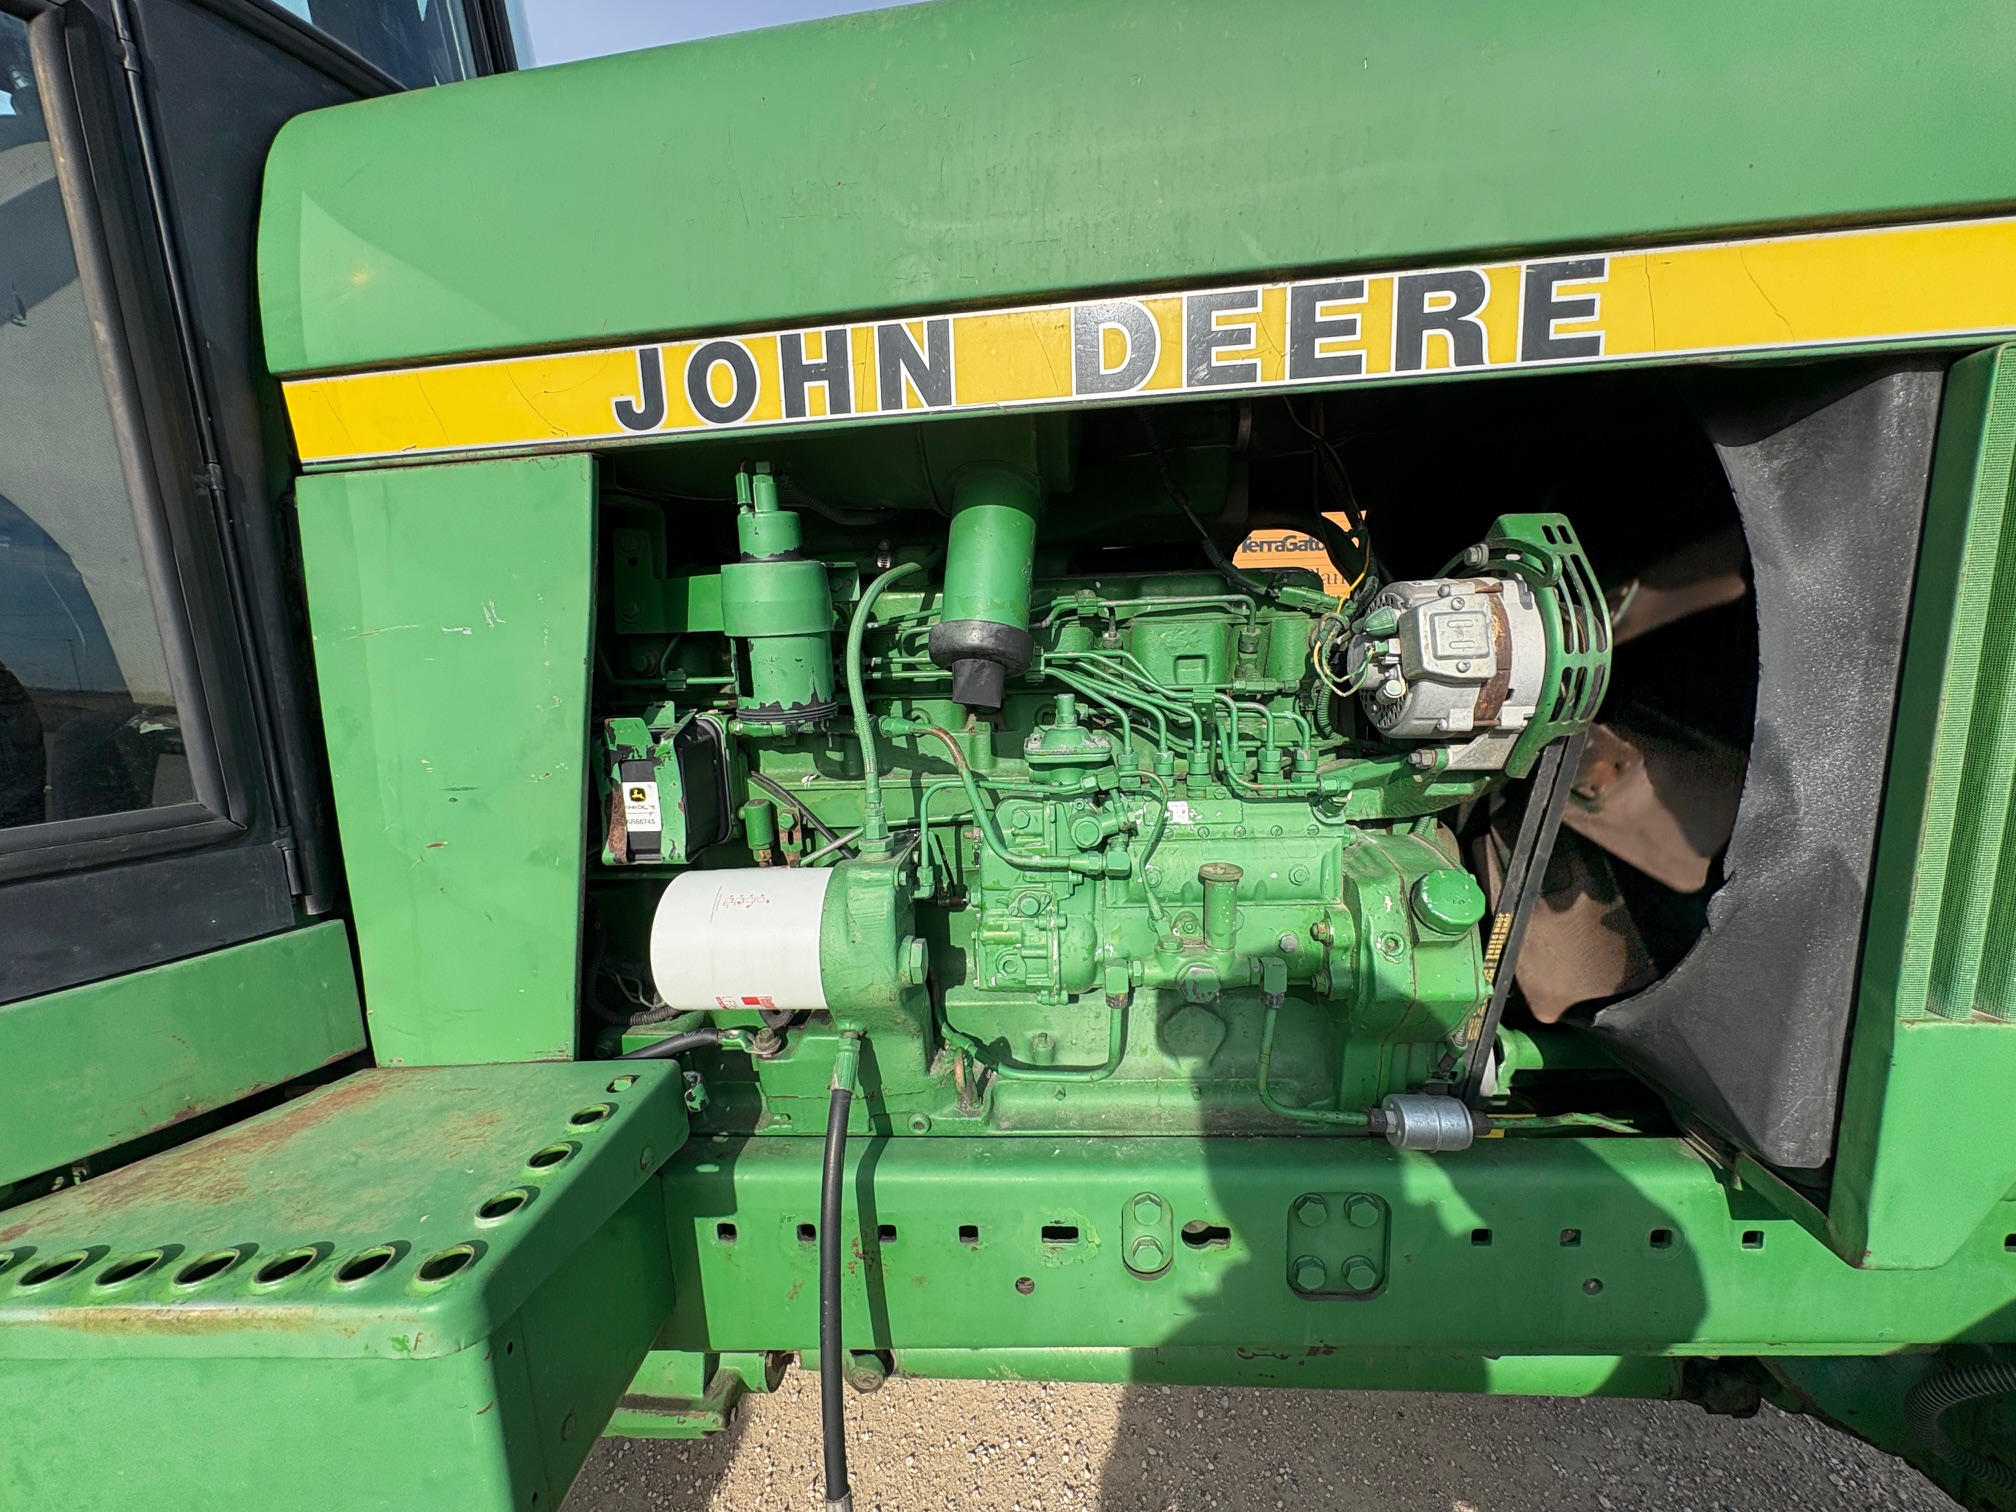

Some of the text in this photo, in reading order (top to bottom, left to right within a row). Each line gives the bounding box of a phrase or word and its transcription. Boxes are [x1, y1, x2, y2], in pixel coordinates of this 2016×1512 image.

[613, 256, 1606, 432] JOHN DEERE
[1241, 534, 1325, 553] TerraGato
